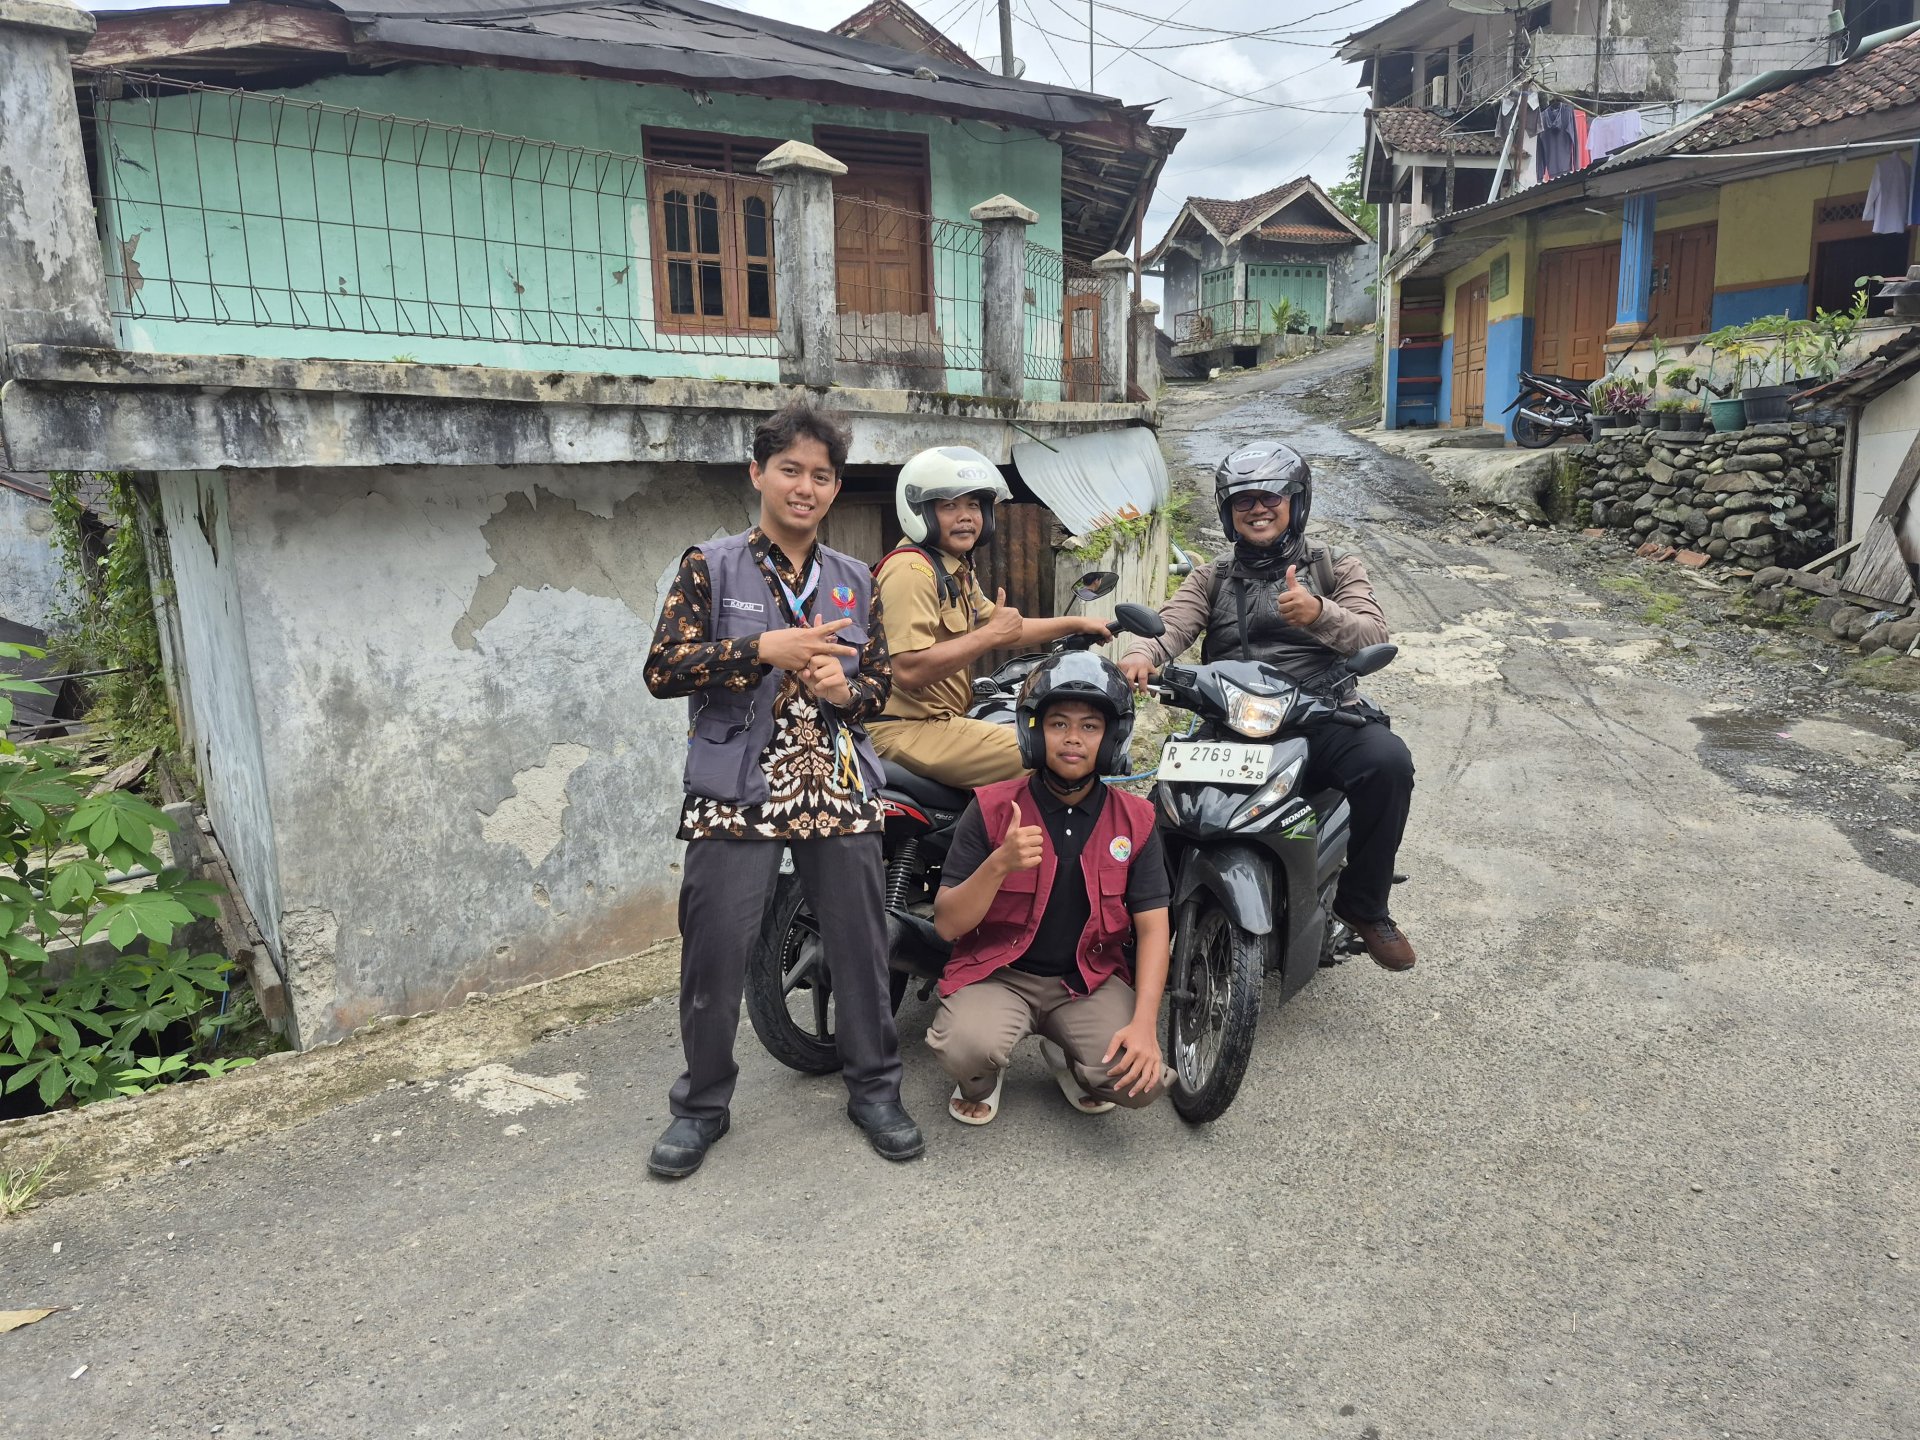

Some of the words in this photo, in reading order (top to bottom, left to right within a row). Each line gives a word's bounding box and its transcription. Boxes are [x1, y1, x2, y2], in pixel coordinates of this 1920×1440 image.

[1167, 746, 1178, 762] R
[1189, 746, 1232, 762] 2769
[1244, 749, 1265, 764] WL
[1280, 804, 1312, 828] HONDA
